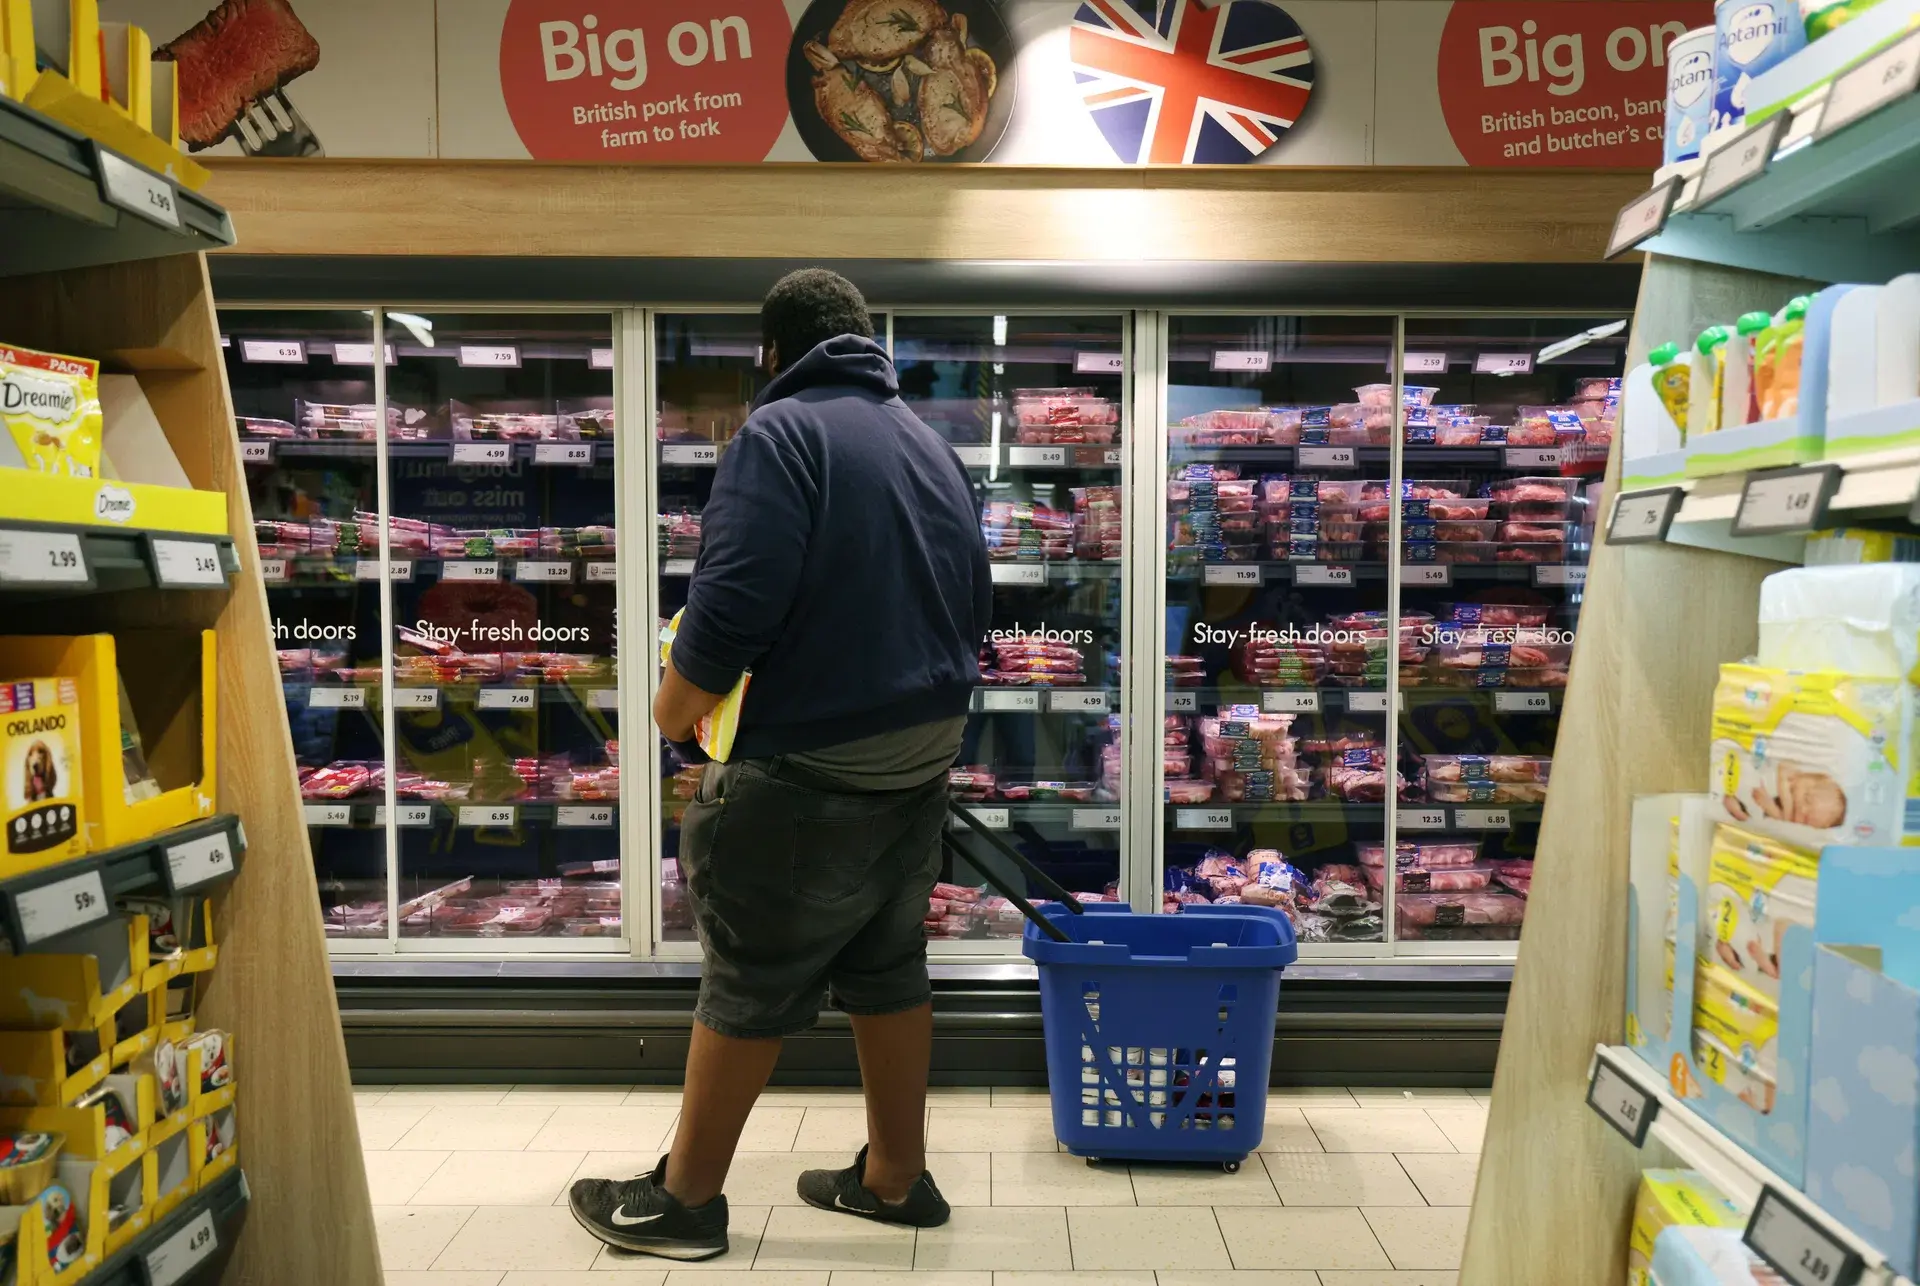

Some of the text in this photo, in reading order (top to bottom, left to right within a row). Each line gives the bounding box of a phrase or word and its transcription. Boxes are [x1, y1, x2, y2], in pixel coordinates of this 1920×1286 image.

[1719, 16, 1789, 50] Aptamil
[539, 14, 752, 91] Big on
[1478, 20, 1687, 96] Big on
[573, 91, 742, 125] British pork from
[1481, 109, 1545, 134] British
[1551, 104, 1619, 127] bacon,
[601, 117, 721, 148] farm to fork
[1503, 135, 1541, 157] and
[1547, 125, 1639, 153] butcher's
[148, 189, 171, 211] 2.99
[279, 348, 297, 356] 6.39
[494, 353, 511, 361] 7.59
[1246, 357, 1263, 365] 7.39
[1508, 359, 1526, 367] 2.49
[49, 358, 89, 377] PACK
[246, 448, 265, 456] 6.99
[486, 450, 505, 458] 4.99
[568, 450, 586, 458] 8.85
[693, 451, 715, 459] 12.99
[1042, 453, 1060, 461] 8.49
[1538, 454, 1556, 462] 6.19
[49, 551, 76, 567] 2.99
[196, 557, 215, 571] 3.49
[474, 567, 494, 575] 13.29
[547, 568, 568, 576] 13.29
[1236, 571, 1256, 579] 11.99
[1328, 571, 1347, 579] 4.69
[1425, 571, 1443, 579] 5.49
[294, 617, 357, 640] doors
[415, 618, 590, 647] Stay-fresh doors
[1031, 622, 1093, 644] doors
[1193, 622, 1367, 649] Stay-fresh doors
[1420, 623, 1525, 650] Stay-fresh
[343, 694, 359, 702] 5.19
[511, 695, 529, 703] 7.49
[1016, 697, 1034, 705] 5.49
[1083, 697, 1101, 705] 4.99
[1174, 698, 1191, 706] 4.75
[1296, 698, 1313, 706] 3.49
[1528, 698, 1546, 706] 6.69
[7, 714, 66, 736] ORLANDO
[327, 812, 345, 820] 5.49
[408, 812, 426, 820] 5.69
[491, 813, 509, 821] 6.95
[590, 813, 608, 821] 4.69
[1207, 815, 1228, 823] 10.49
[1487, 816, 1505, 824] 6.89
[190, 1226, 210, 1252] 4.99
